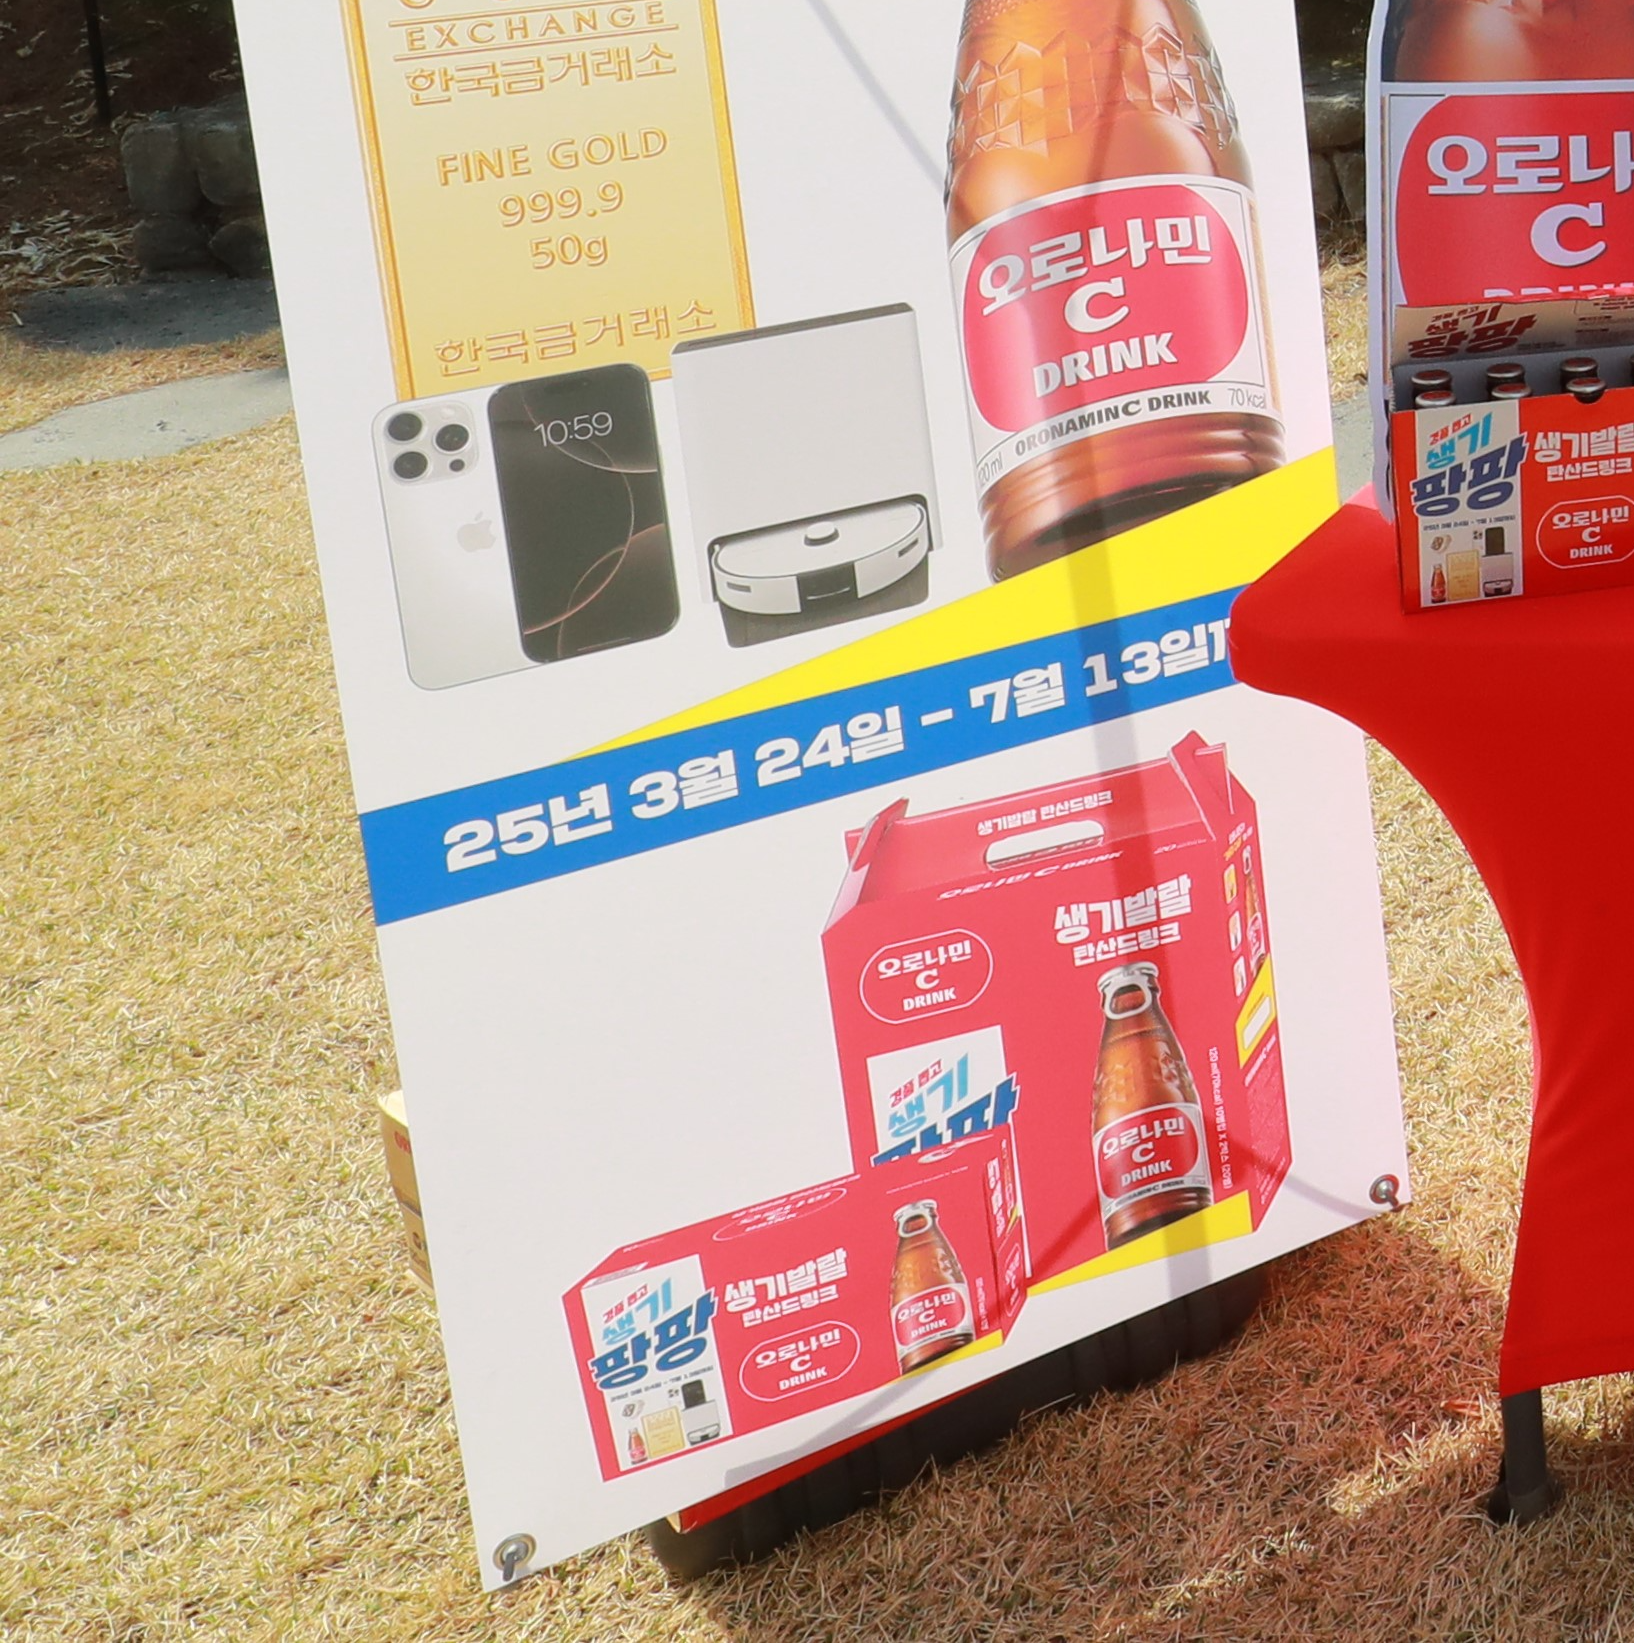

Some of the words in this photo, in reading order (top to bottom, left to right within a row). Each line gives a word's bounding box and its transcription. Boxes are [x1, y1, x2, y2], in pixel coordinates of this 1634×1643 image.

[402, 0, 667, 51] EXCHANGE
[402, 40, 680, 107] 한국금거래소
[436, 147, 533, 189] FINE
[545, 125, 669, 180] GOLD
[496, 178, 625, 230] 999.9
[528, 232, 610, 273] 50g
[1531, 202, 1606, 267] C
[978, 213, 1212, 318] 오로나민
[1062, 277, 1131, 335] C
[431, 297, 718, 377] 한국금거래소
[1032, 328, 1178, 398] DRINK
[1148, 390, 1212, 412] DRINK
[534, 410, 613, 447] 10:59
[1425, 411, 1493, 470] 생기
[1412, 432, 1528, 517] 팡팡
[1546, 458, 1633, 483] 탄산드링크
[1552, 505, 1629, 530] 오로나민
[1581, 524, 1601, 543] C
[1570, 543, 1613, 559] DRINK
[442, 787, 614, 874] 25년
[628, 747, 741, 823] 3월
[753, 705, 905, 790] 24일
[968, 660, 1067, 726] 7월
[1083, 618, 1230, 697] 13일
[1053, 874, 1193, 943] 생기발랄
[877, 939, 972, 980] 오로나민
[1073, 922, 1182, 967] 탄산드링크
[903, 988, 956, 1011] DRINK
[916, 969, 940, 989] C
[1101, 1116, 1185, 1159] 오로나민
[1132, 1142, 1156, 1165] C
[1121, 1158, 1173, 1188] DRINK
